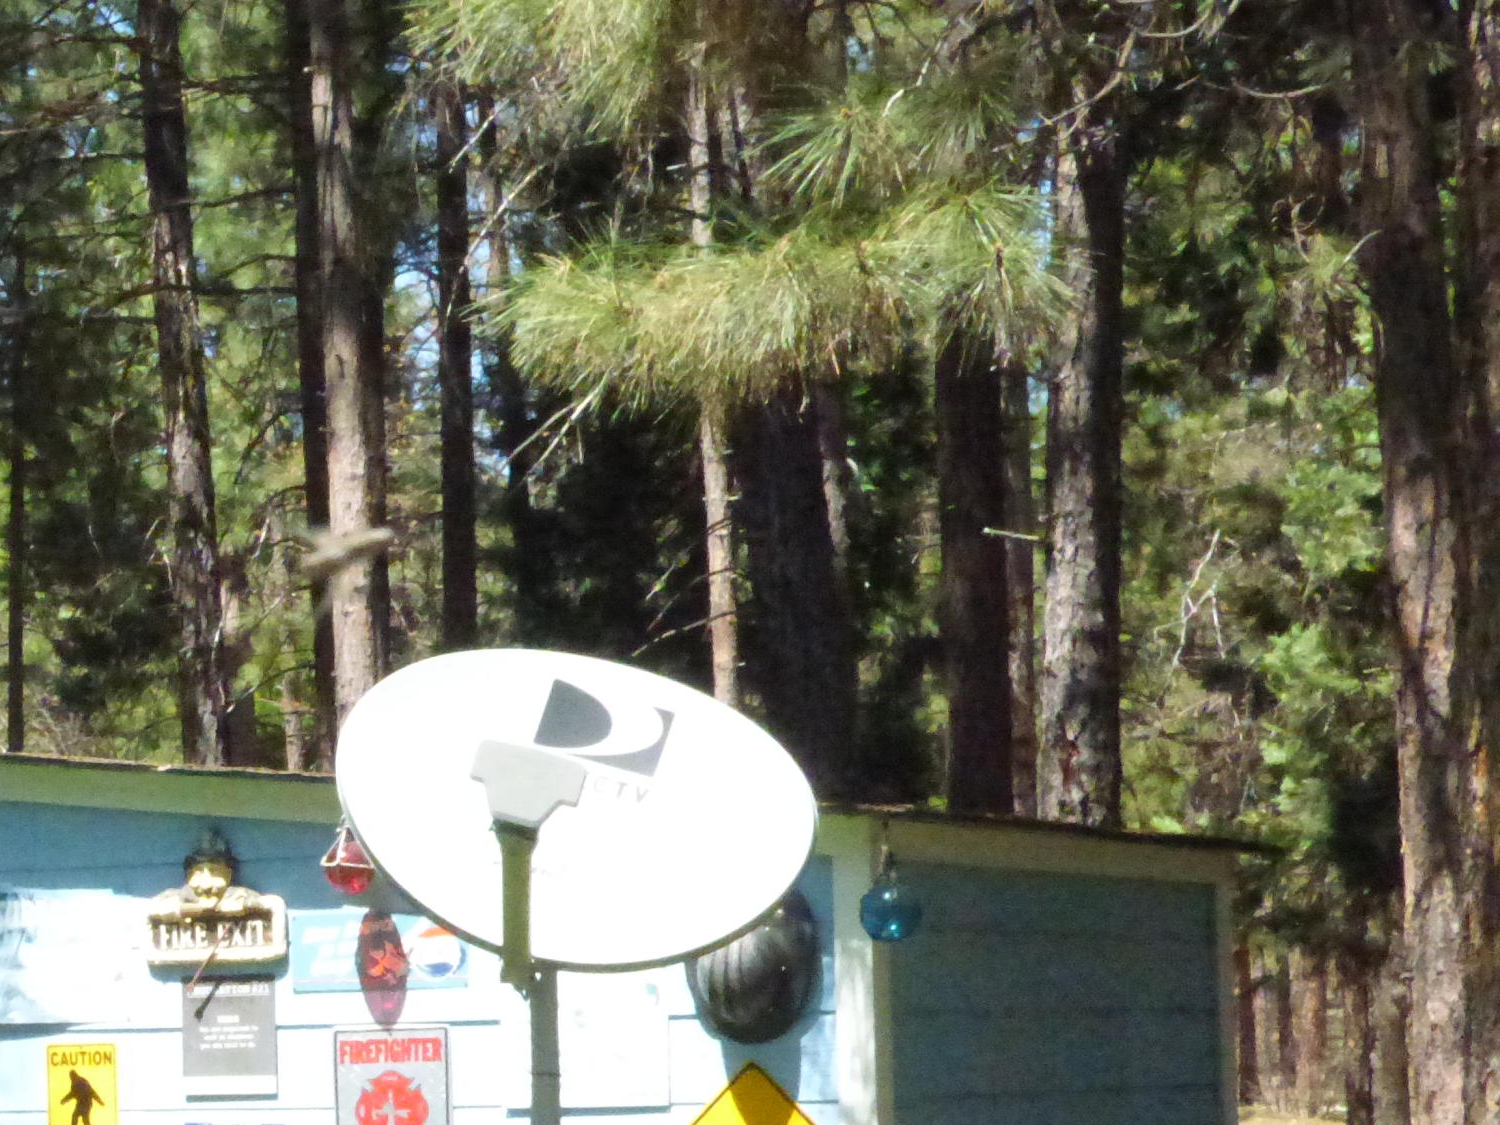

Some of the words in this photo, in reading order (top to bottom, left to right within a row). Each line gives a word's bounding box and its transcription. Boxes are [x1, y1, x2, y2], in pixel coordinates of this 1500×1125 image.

[159, 924, 208, 950] FIRE
[217, 919, 265, 947] EXIT
[51, 1051, 112, 1066] CAUTION
[339, 1037, 443, 1064] FIREFIGHTER
